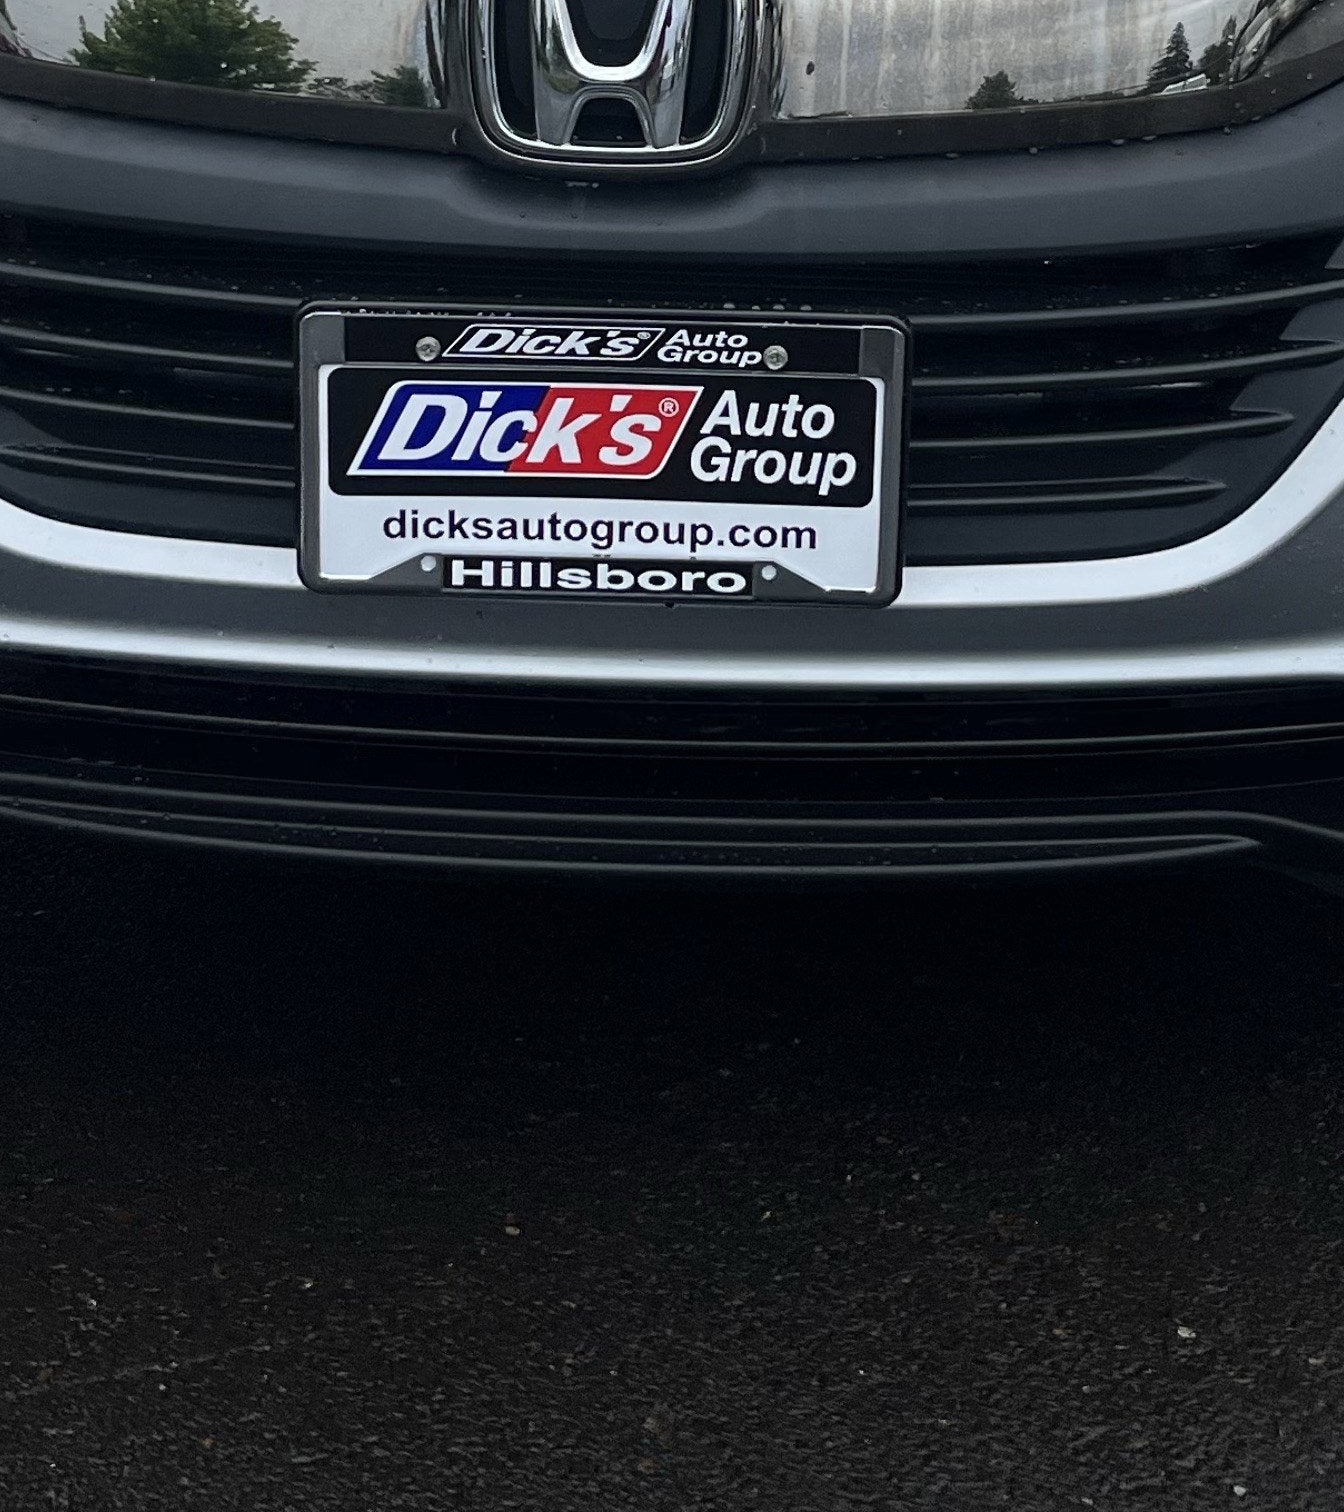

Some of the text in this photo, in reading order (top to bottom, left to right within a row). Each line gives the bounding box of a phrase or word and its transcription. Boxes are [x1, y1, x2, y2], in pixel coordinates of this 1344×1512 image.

[657, 345, 762, 368] Group
[666, 329, 748, 348] Auto
[699, 389, 835, 439] Auto
[690, 436, 857, 496] Group
[382, 510, 817, 552] dicksautogroup.com
[451, 559, 747, 593] Hillsboro
